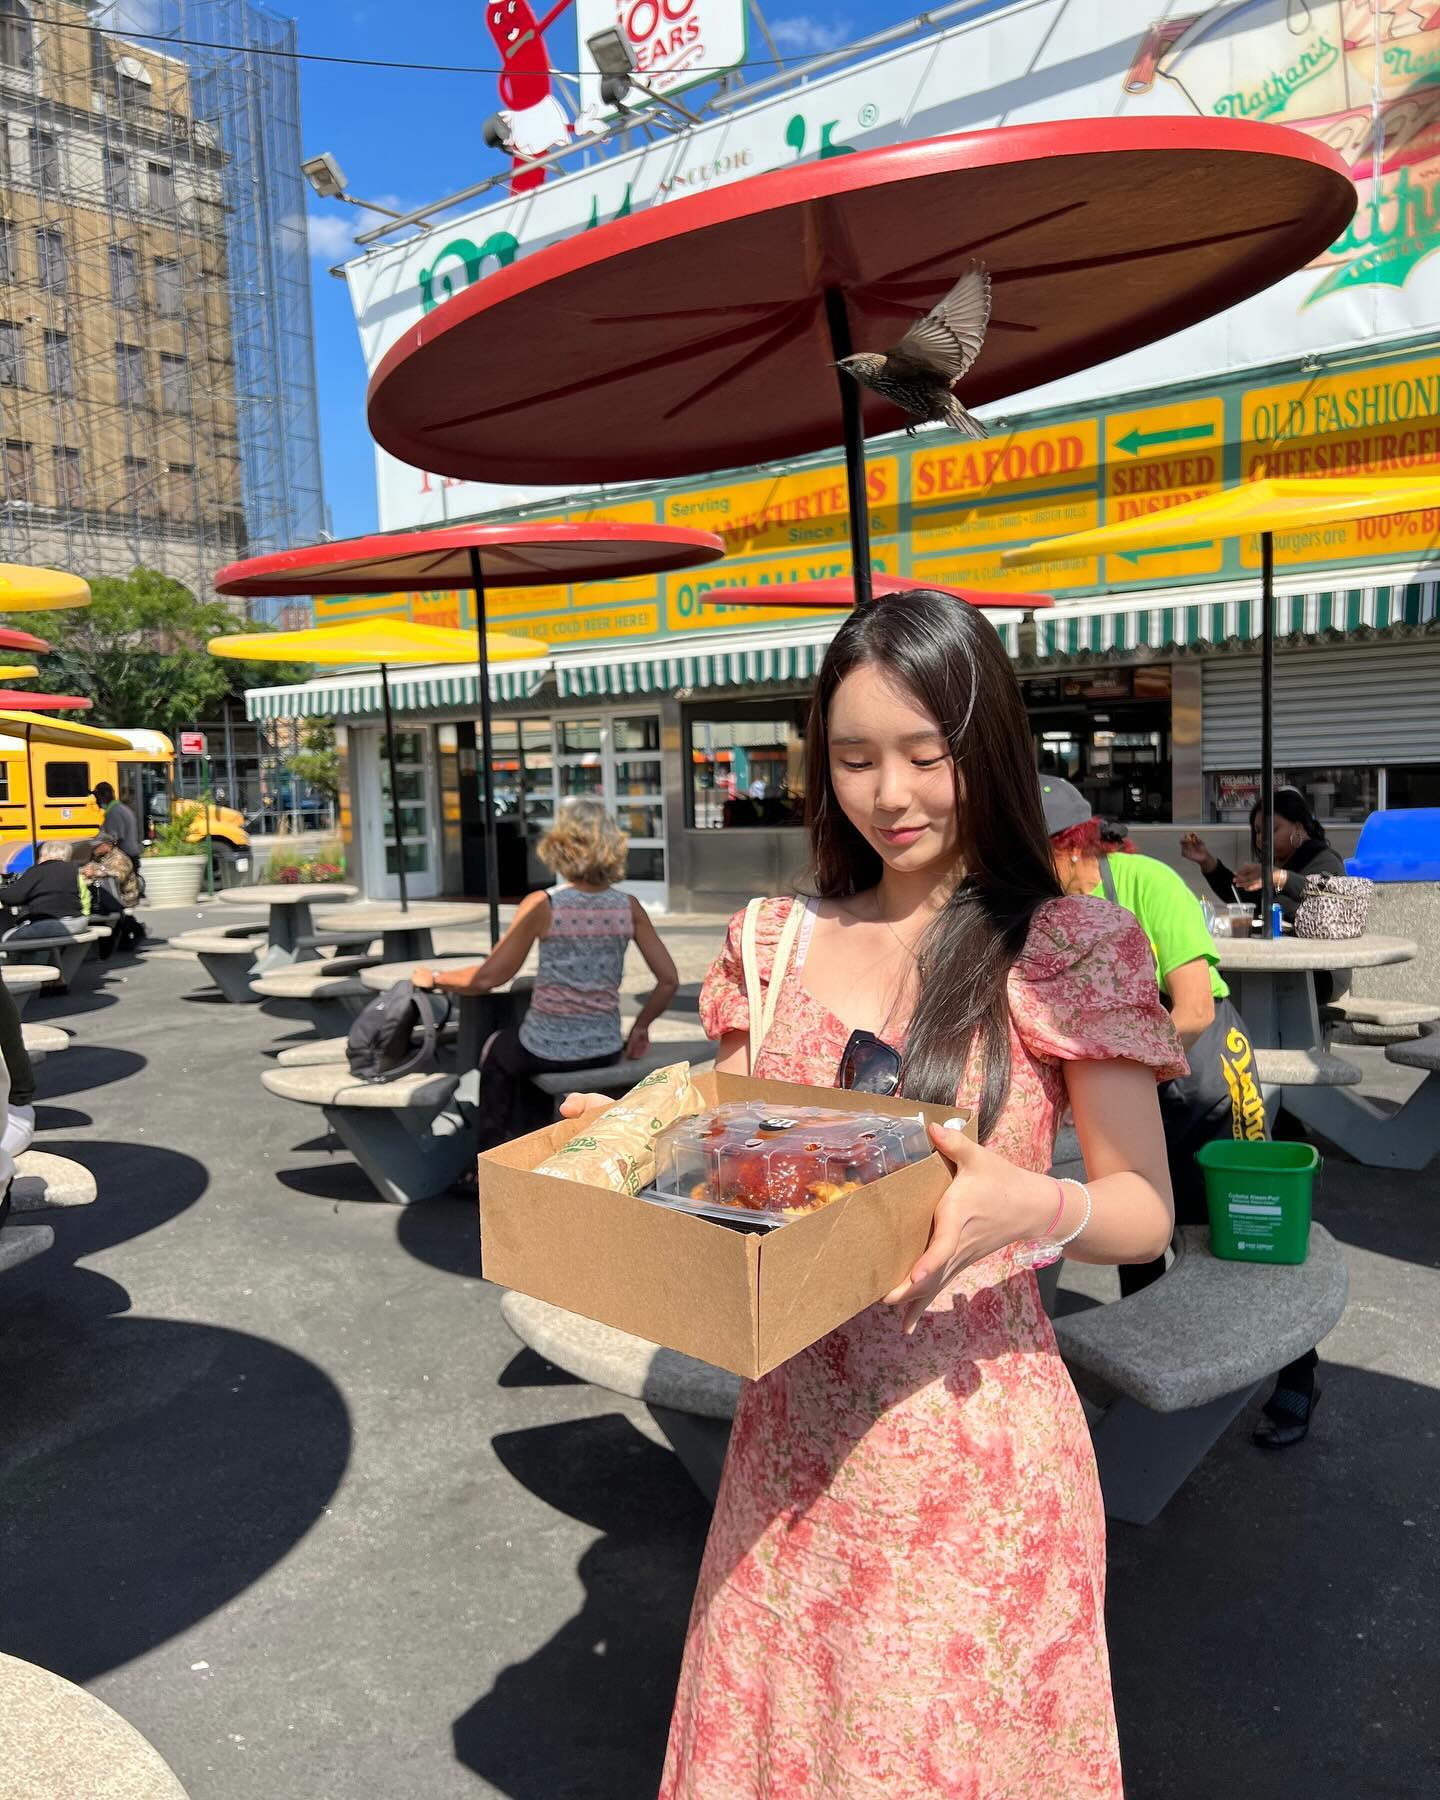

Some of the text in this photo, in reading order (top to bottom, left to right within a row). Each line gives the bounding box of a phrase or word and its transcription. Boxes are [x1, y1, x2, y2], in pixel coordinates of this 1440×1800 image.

[631, 15, 701, 73] EARS
[1253, 399, 1306, 444] OLD
[917, 435, 1085, 497] SEAFOOD
[1113, 455, 1216, 496] SERVED
[671, 497, 730, 518] Serving
[1355, 513, 1418, 543] 100%
[788, 523, 834, 543] Since
